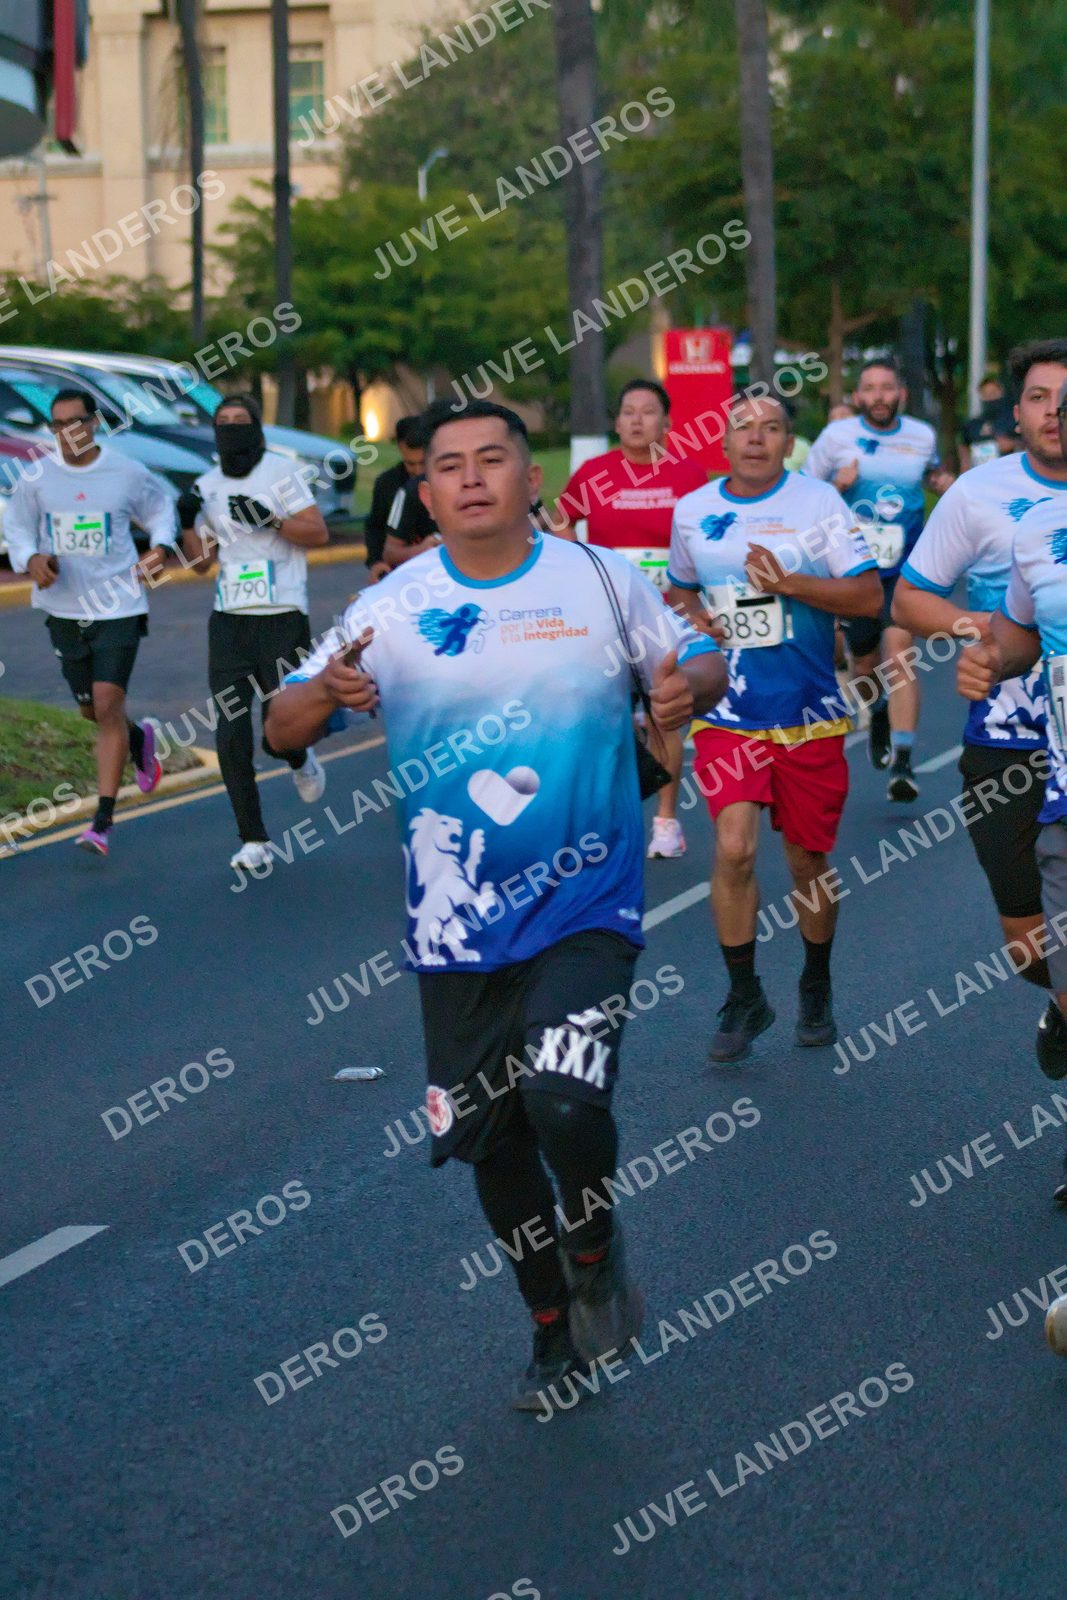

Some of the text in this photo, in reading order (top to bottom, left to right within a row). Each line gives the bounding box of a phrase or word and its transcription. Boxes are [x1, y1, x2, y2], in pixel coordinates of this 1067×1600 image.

[56, 531, 104, 551] 1349
[223, 581, 268, 602] 1790
[500, 607, 562, 621] Carrera
[536, 617, 565, 629] Vida
[716, 609, 770, 640] 383
[524, 627, 588, 641] Integridad
